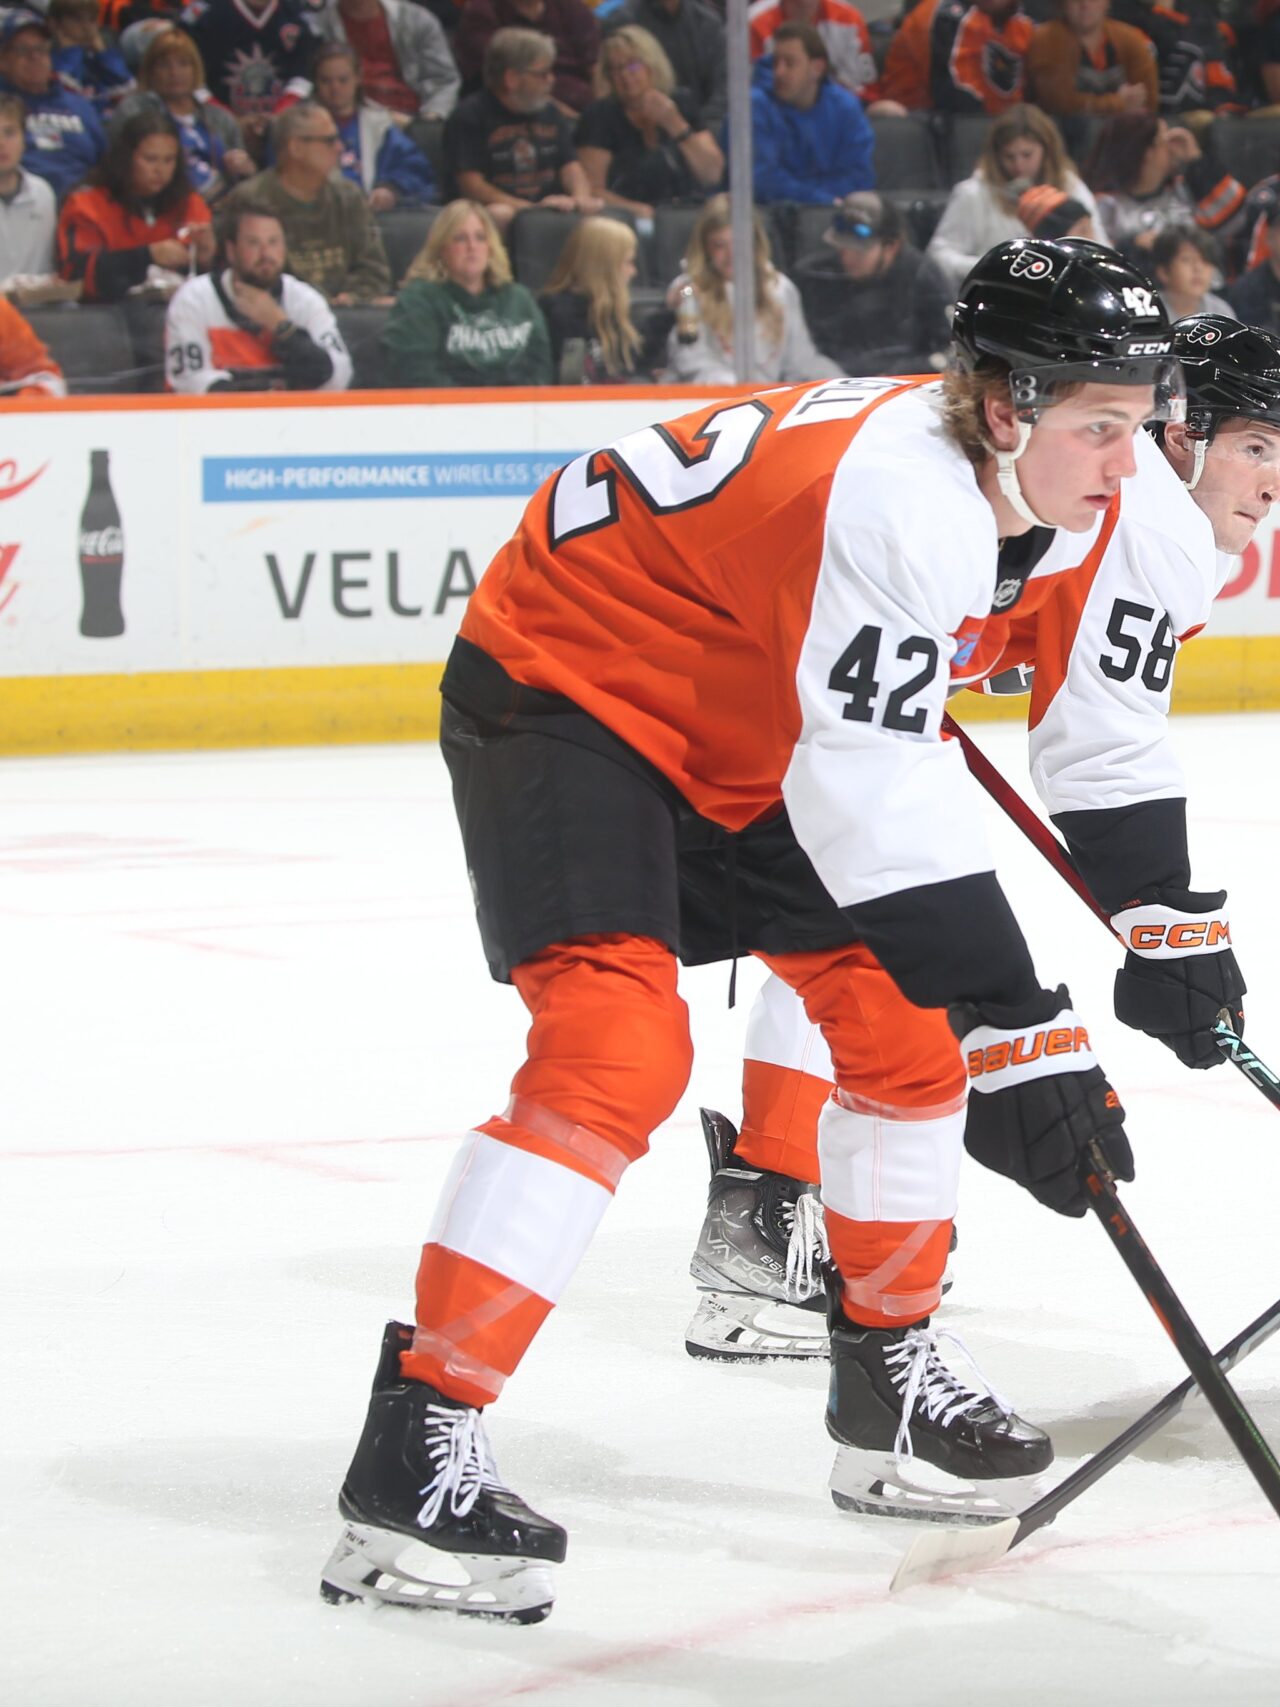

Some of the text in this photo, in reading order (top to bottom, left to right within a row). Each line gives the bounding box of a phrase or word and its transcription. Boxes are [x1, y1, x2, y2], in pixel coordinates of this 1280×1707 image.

[1122, 287, 1160, 317] 42
[1127, 341, 1171, 355] CCM
[225, 465, 430, 490] HIGH-PERFORMANCE
[434, 463, 528, 485] WIRELESS
[1099, 597, 1177, 693] 58
[827, 624, 939, 734] 42
[1130, 920, 1233, 949] CCM
[967, 1026, 1093, 1078] BAUER
